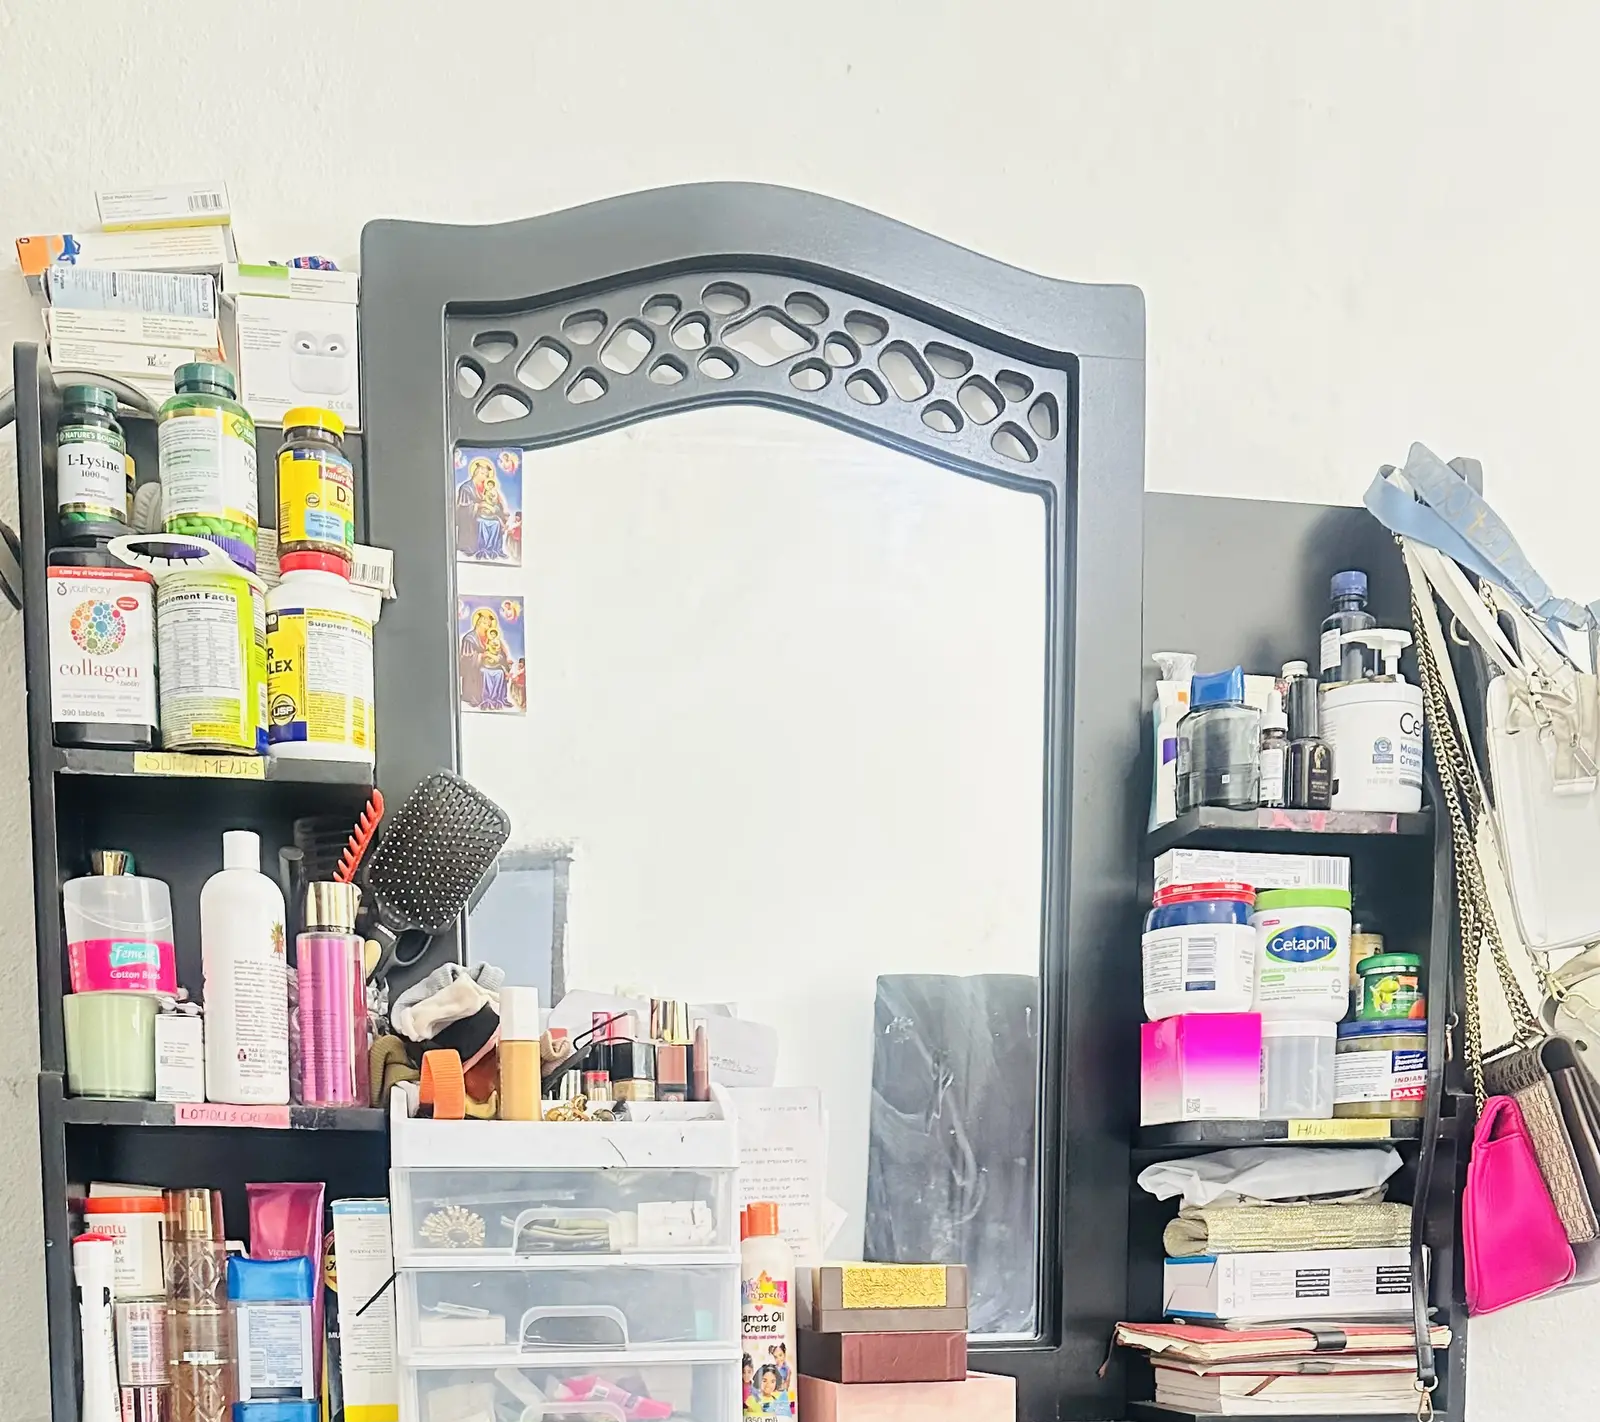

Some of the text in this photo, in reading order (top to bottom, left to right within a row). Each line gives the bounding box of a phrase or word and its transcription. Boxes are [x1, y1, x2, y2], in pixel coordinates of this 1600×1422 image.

[68, 453, 121, 474] L-Lysine
[204, 592, 236, 603] Facts
[59, 657, 139, 683] collagen
[62, 708, 105, 718] 390 tablets
[272, 703, 295, 717] USP
[1271, 936, 1331, 954] Cetaphil
[109, 969, 140, 980] Cotton
[1394, 1075, 1423, 1084] INDIAN
[1392, 1088, 1420, 1099] DAX
[91, 1223, 128, 1234] cantu
[742, 1310, 785, 1323] arrot Oil
[744, 1322, 777, 1333] Creme
